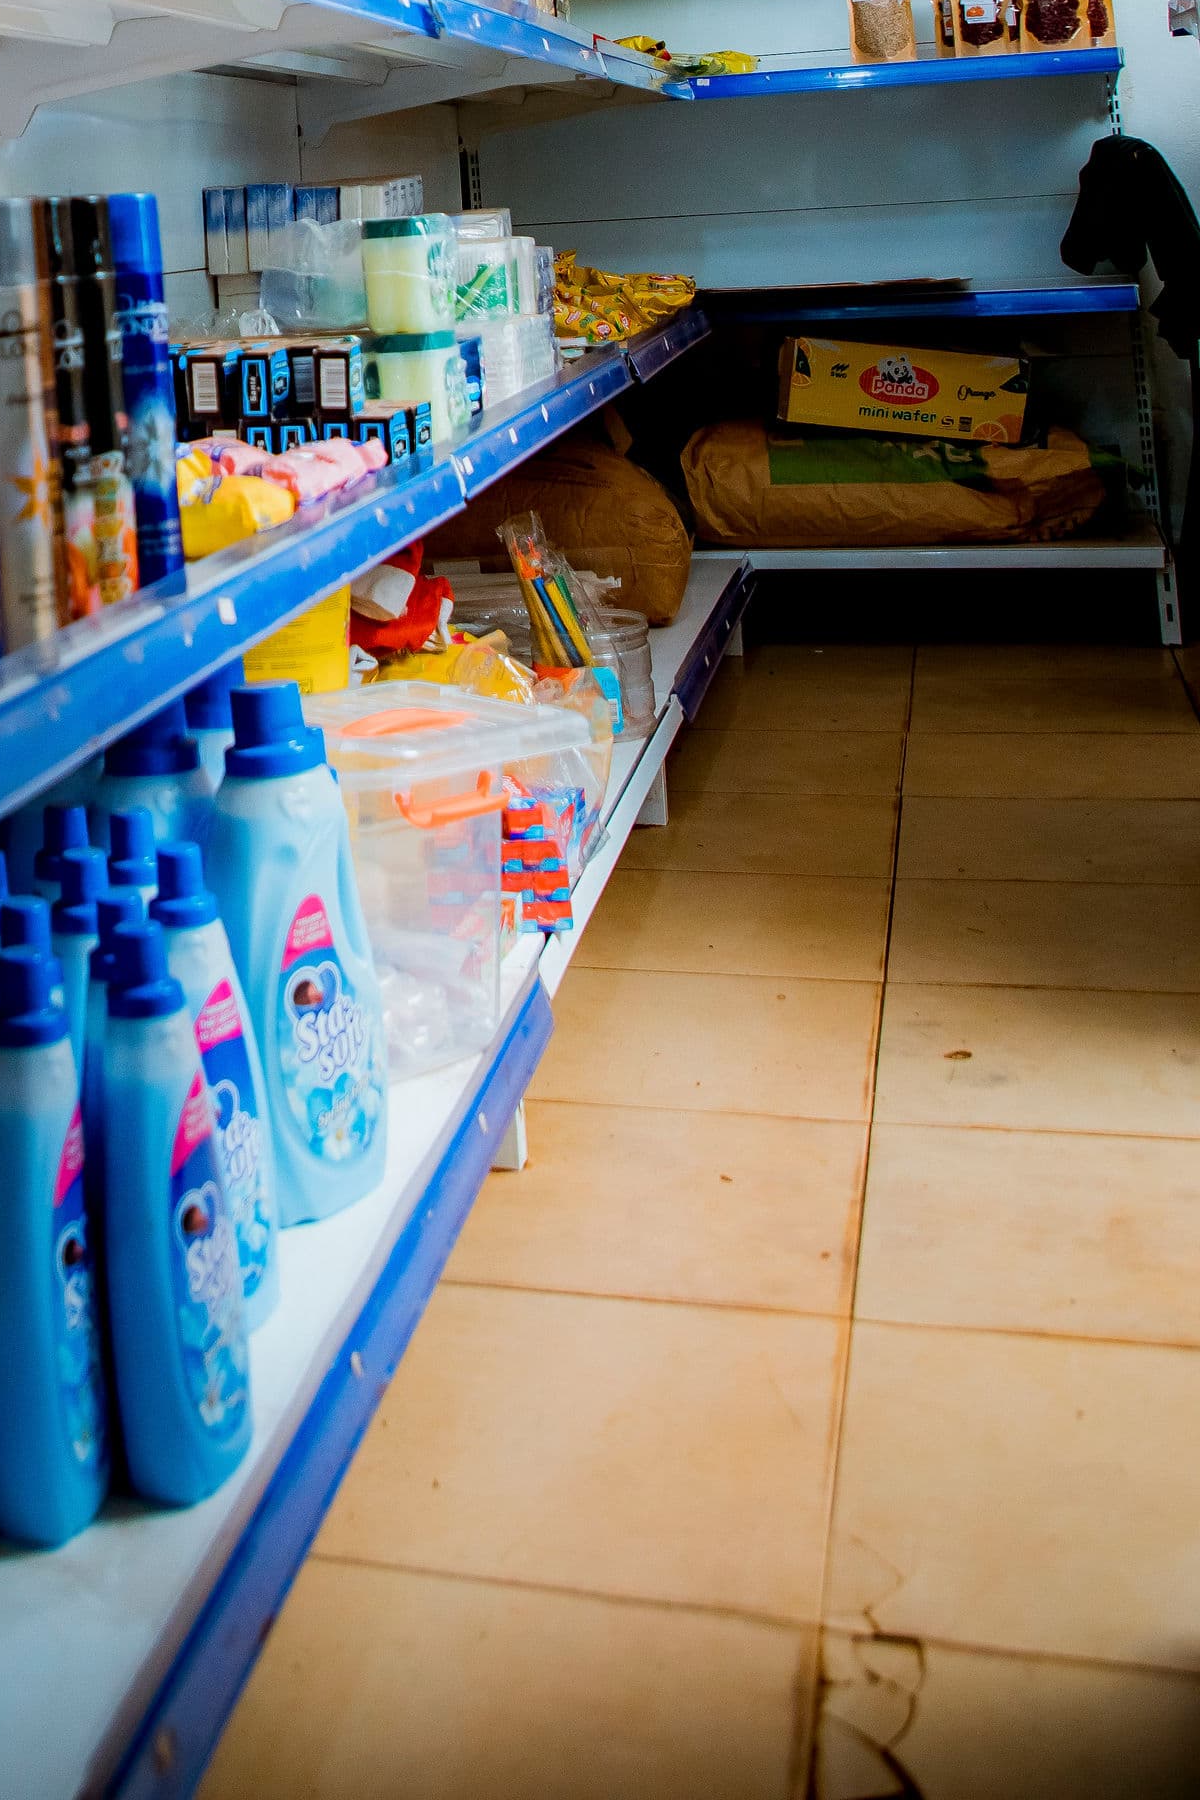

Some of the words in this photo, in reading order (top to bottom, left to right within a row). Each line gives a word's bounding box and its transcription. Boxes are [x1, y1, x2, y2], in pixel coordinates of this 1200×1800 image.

[873, 377, 927, 397] Panda
[957, 384, 997, 401] Orange
[858, 405, 889, 418] mini
[892, 408, 937, 423] wafer
